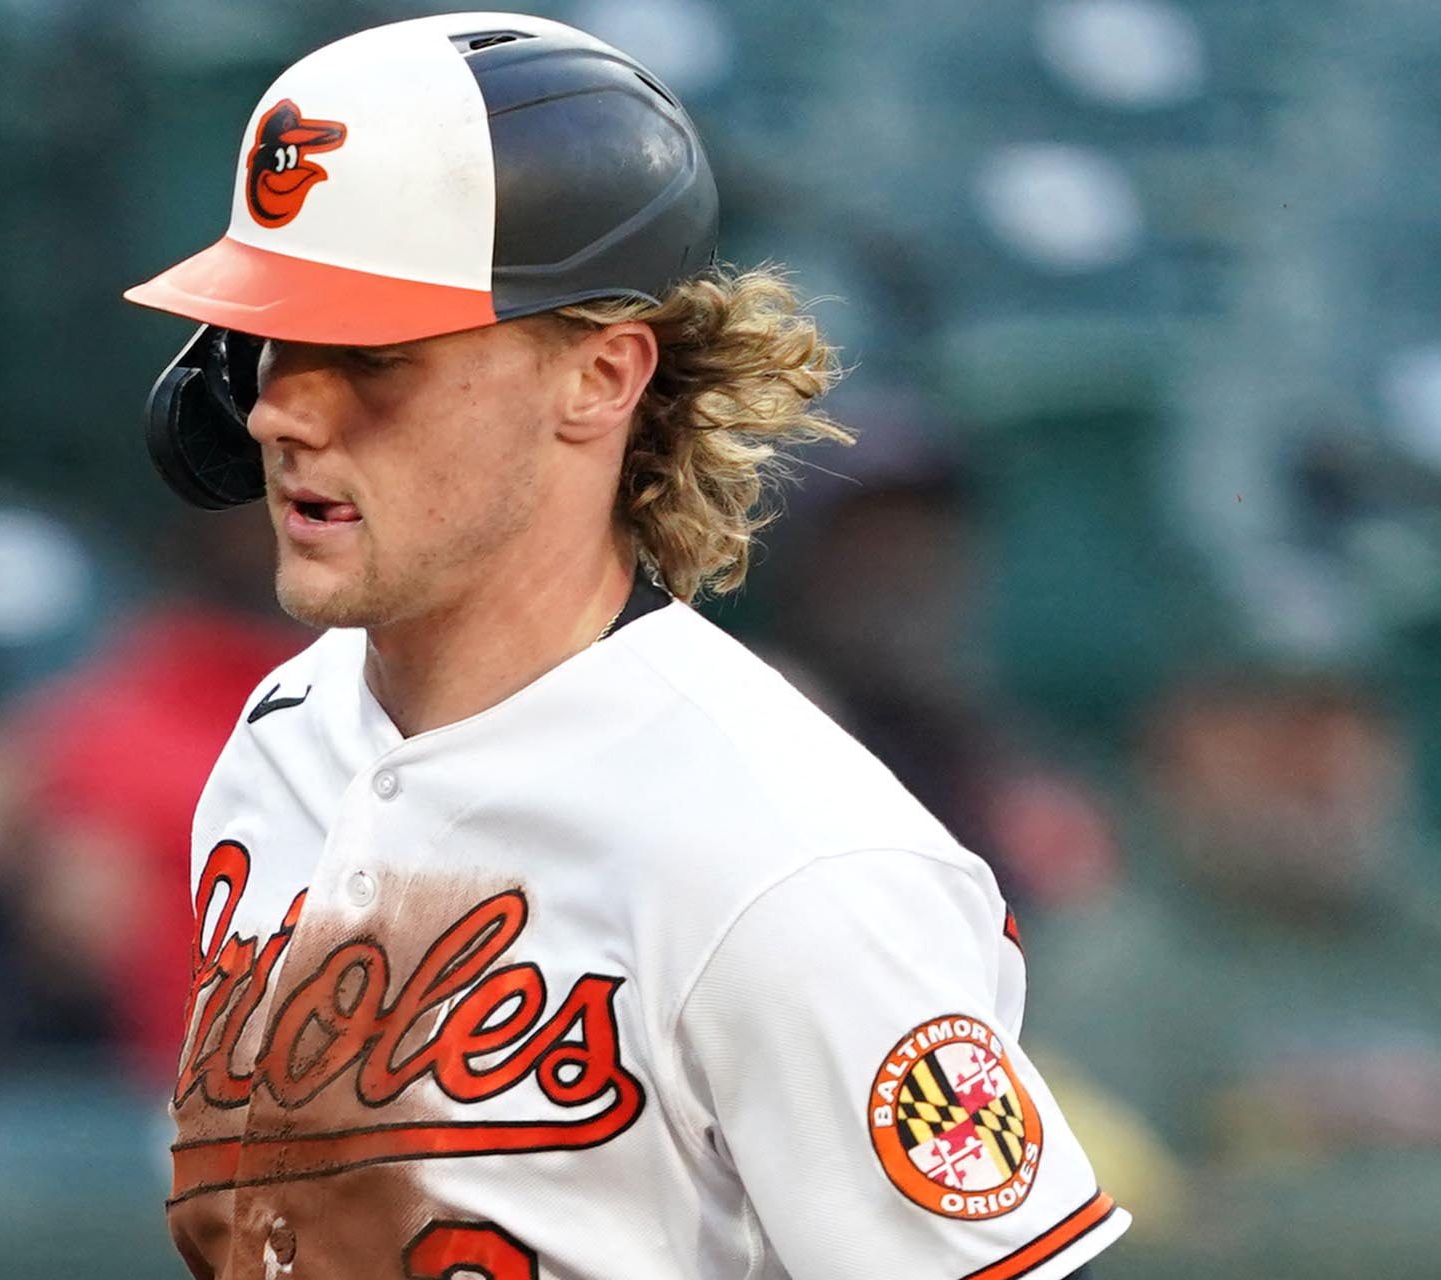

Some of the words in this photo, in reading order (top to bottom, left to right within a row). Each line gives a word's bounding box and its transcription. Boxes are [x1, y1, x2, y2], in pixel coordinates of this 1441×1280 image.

[169, 840, 646, 1155] Orioles
[873, 1018, 1005, 1129] BALTIMORE
[939, 1141, 1040, 1215] ORIOLES
